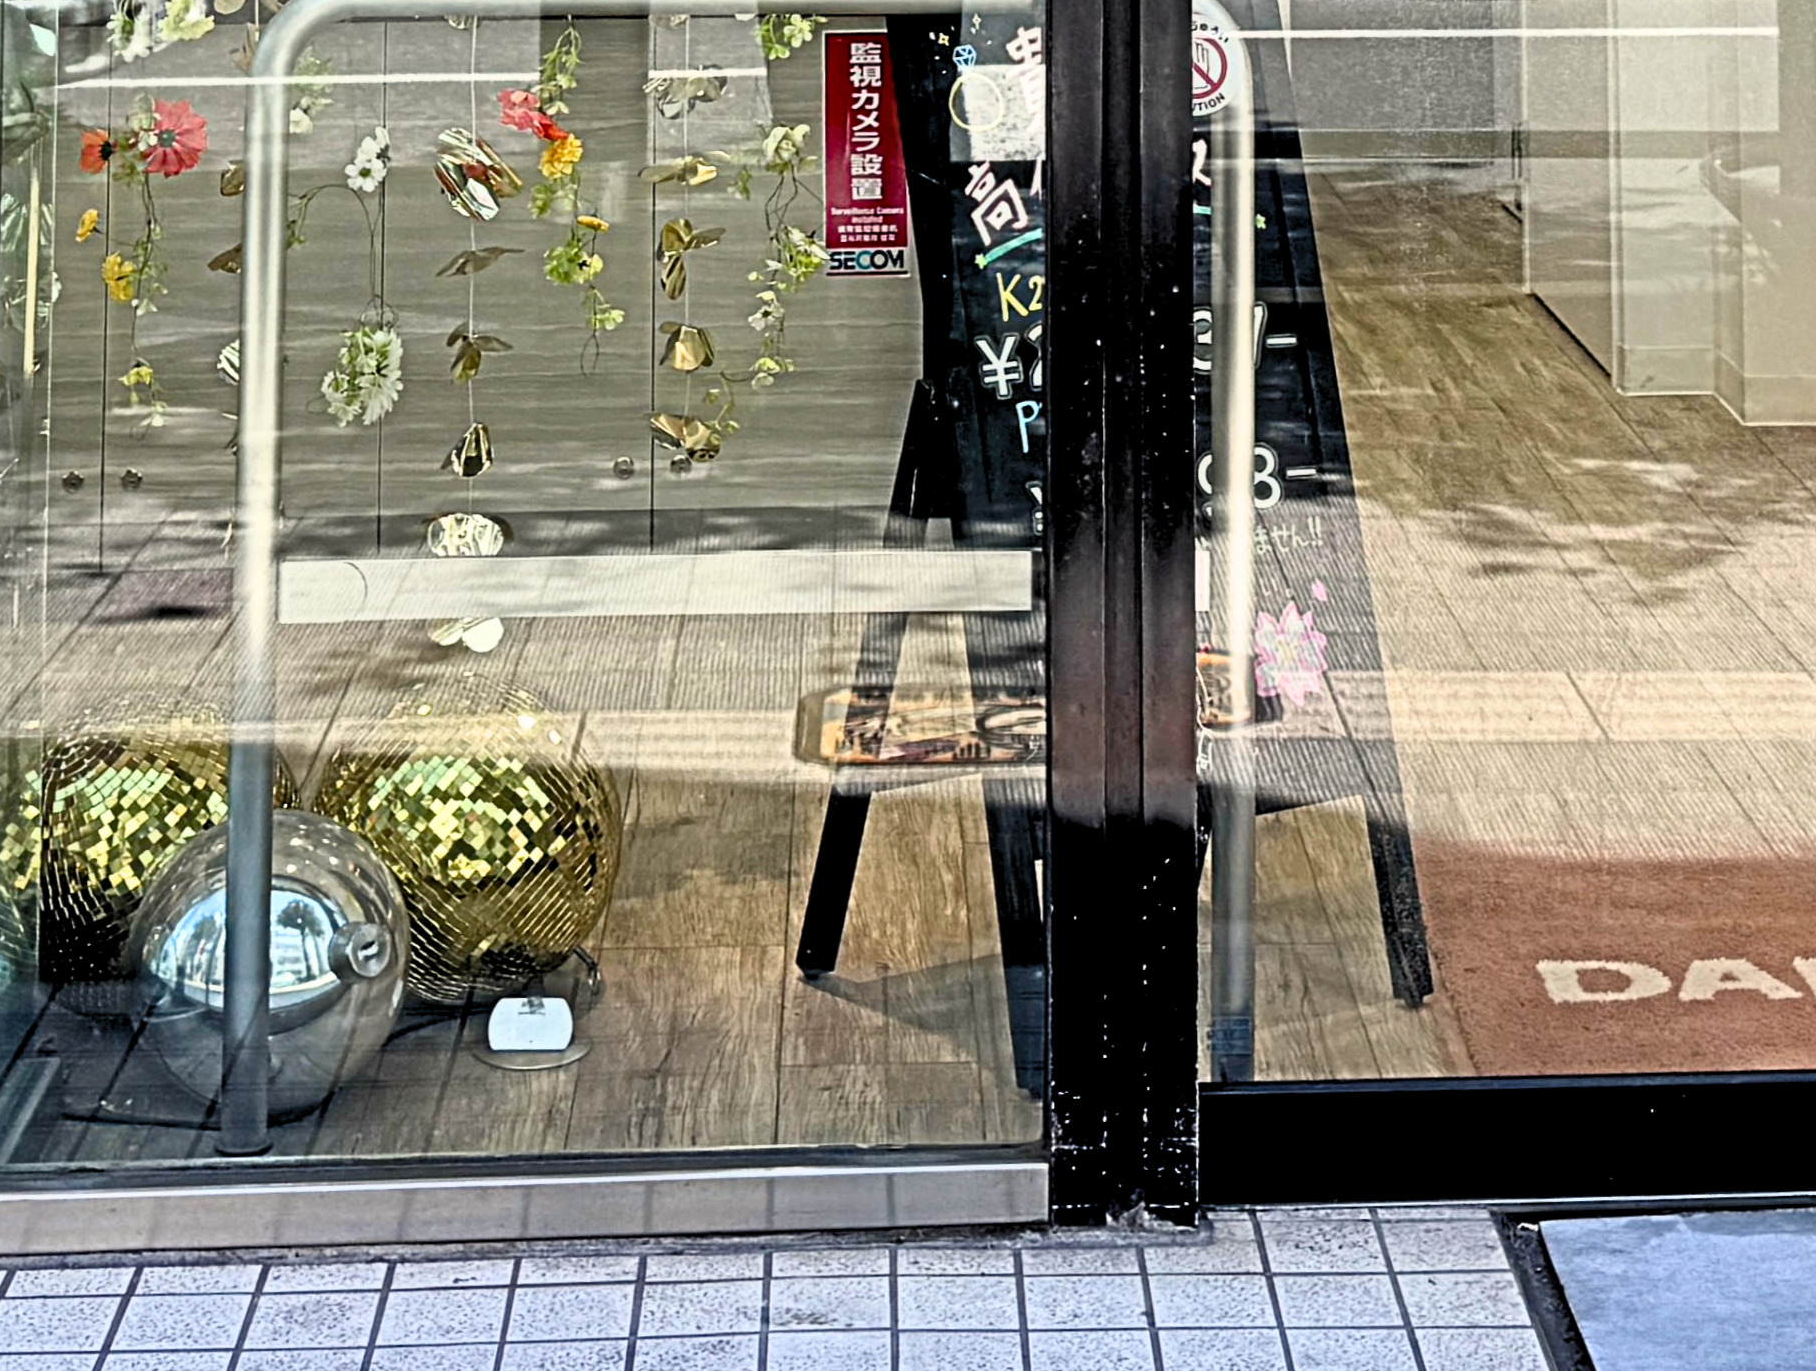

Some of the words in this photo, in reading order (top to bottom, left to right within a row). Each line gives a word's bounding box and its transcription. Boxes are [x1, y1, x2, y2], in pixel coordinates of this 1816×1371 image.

[849, 42, 884, 200] 監視カメラ設置
[965, 161, 1029, 244] 高
[829, 249, 905, 270] SECOM
